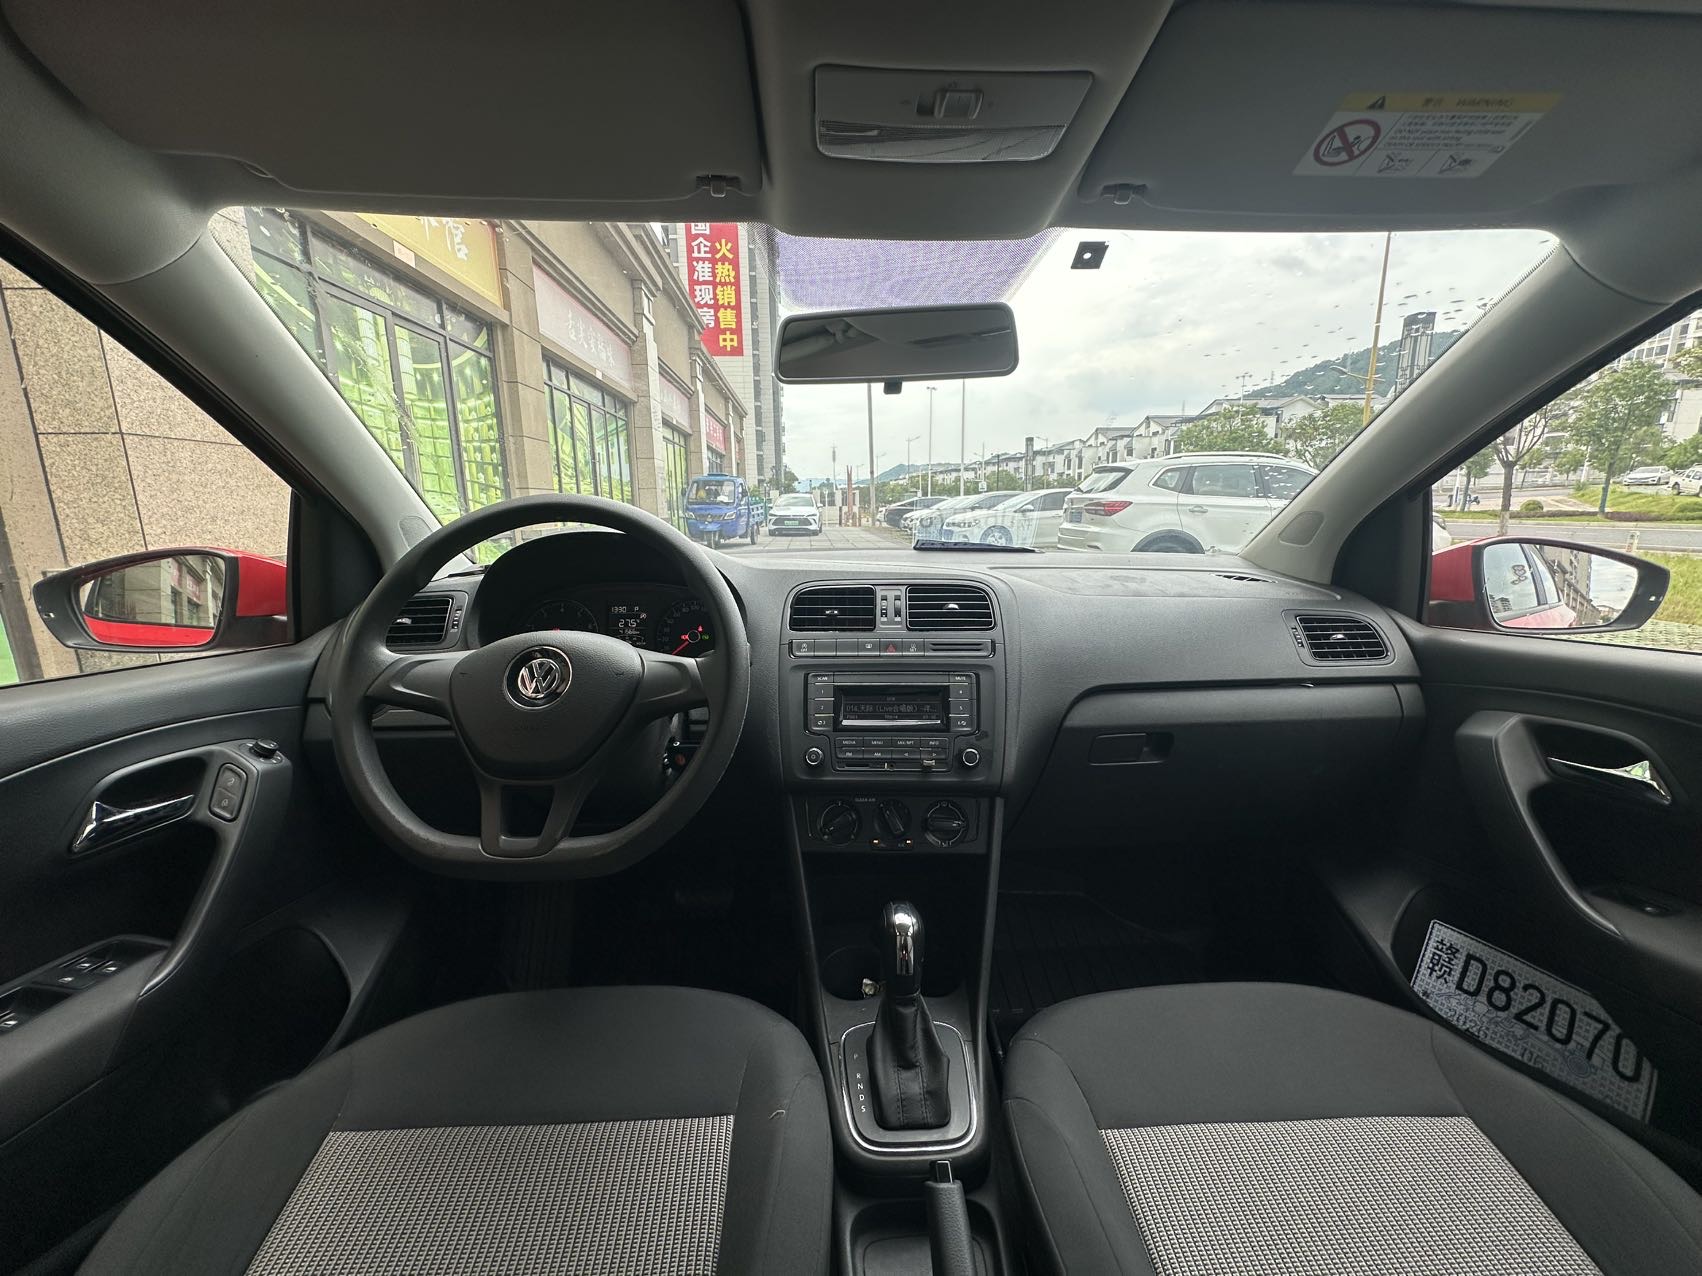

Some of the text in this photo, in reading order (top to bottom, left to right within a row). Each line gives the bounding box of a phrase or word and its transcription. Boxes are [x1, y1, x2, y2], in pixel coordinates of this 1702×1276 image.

[714, 239, 738, 351] 火热销售中
[857, 1082, 863, 1090] N
[861, 1105, 866, 1113] S
